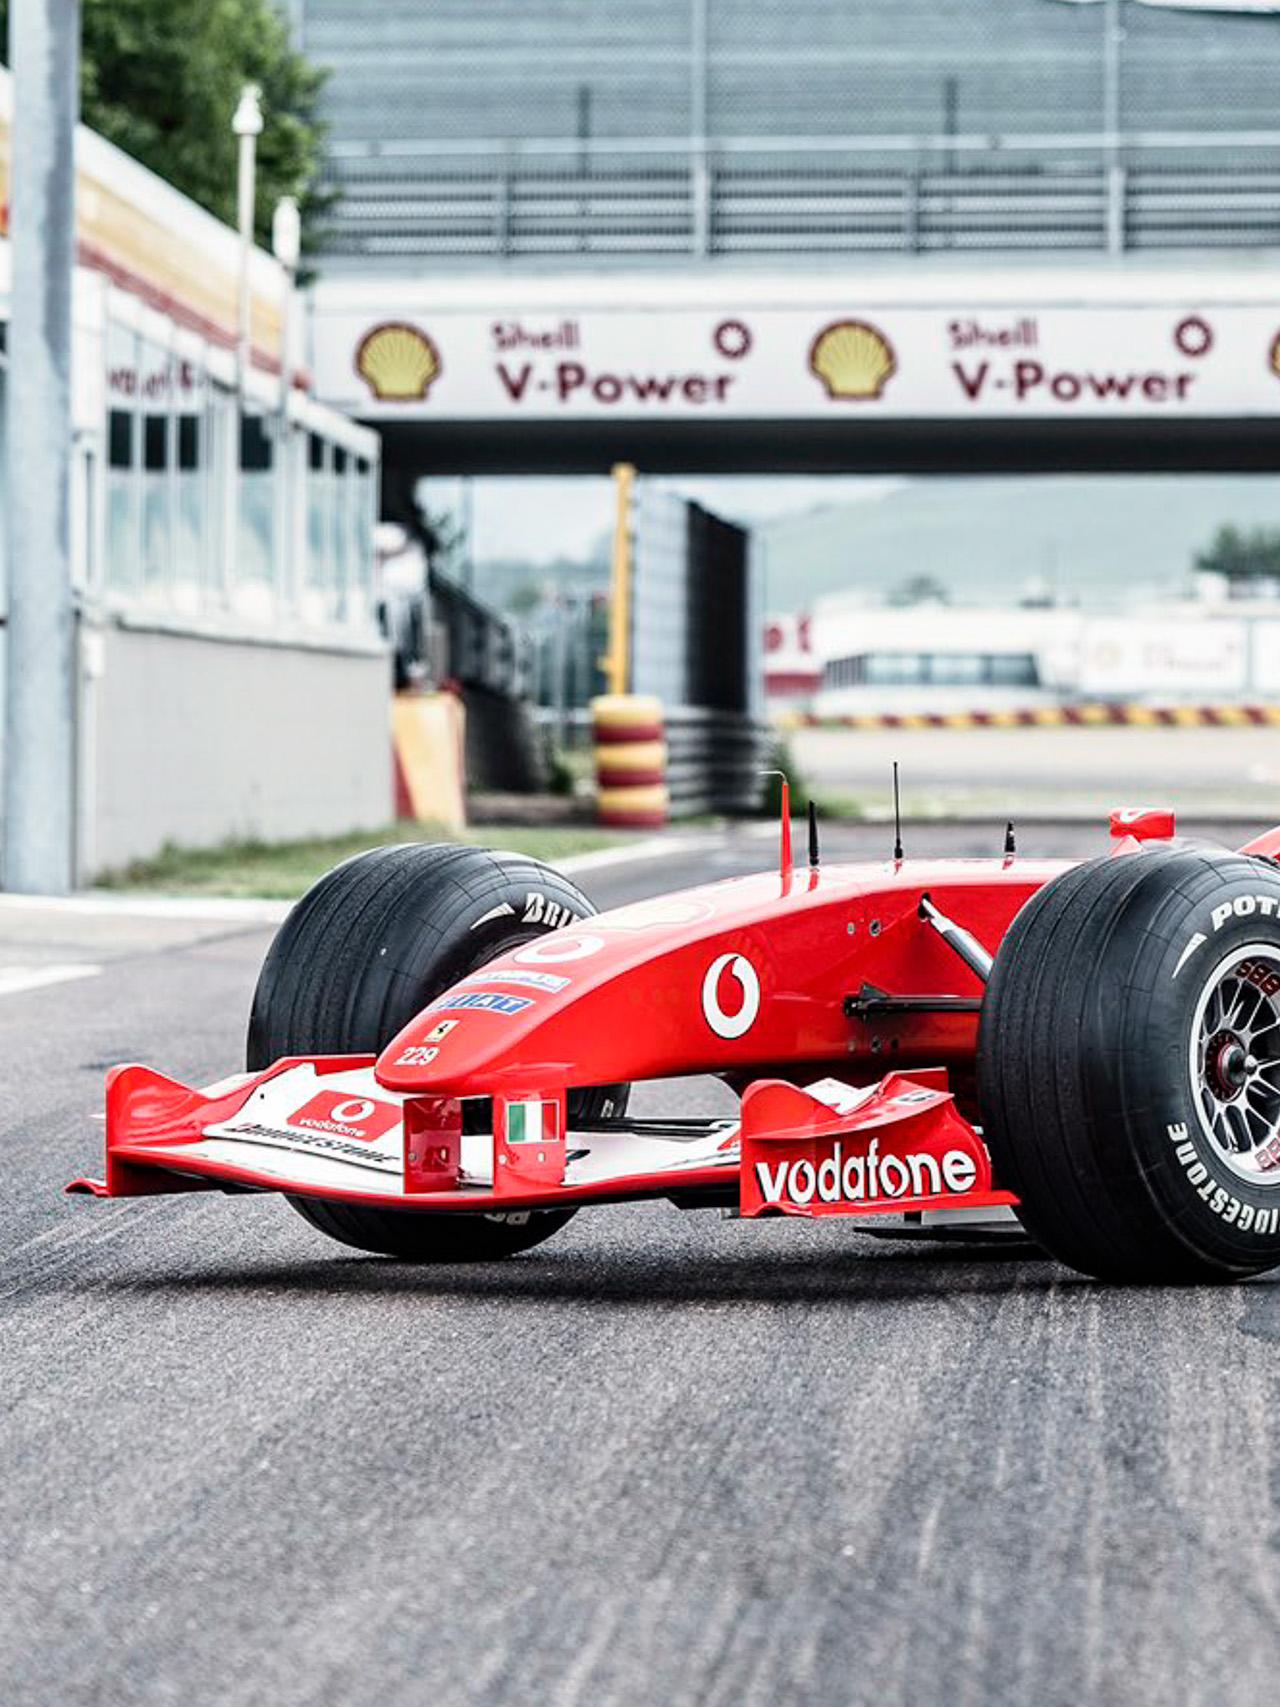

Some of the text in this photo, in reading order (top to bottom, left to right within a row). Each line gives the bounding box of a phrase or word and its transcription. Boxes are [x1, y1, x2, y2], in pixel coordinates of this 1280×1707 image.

[491, 321, 579, 352] Shell
[948, 319, 1037, 350] Shell
[494, 362, 734, 405] V-Power
[950, 361, 1194, 403] V-Power
[756, 1138, 977, 1204] vodafone
